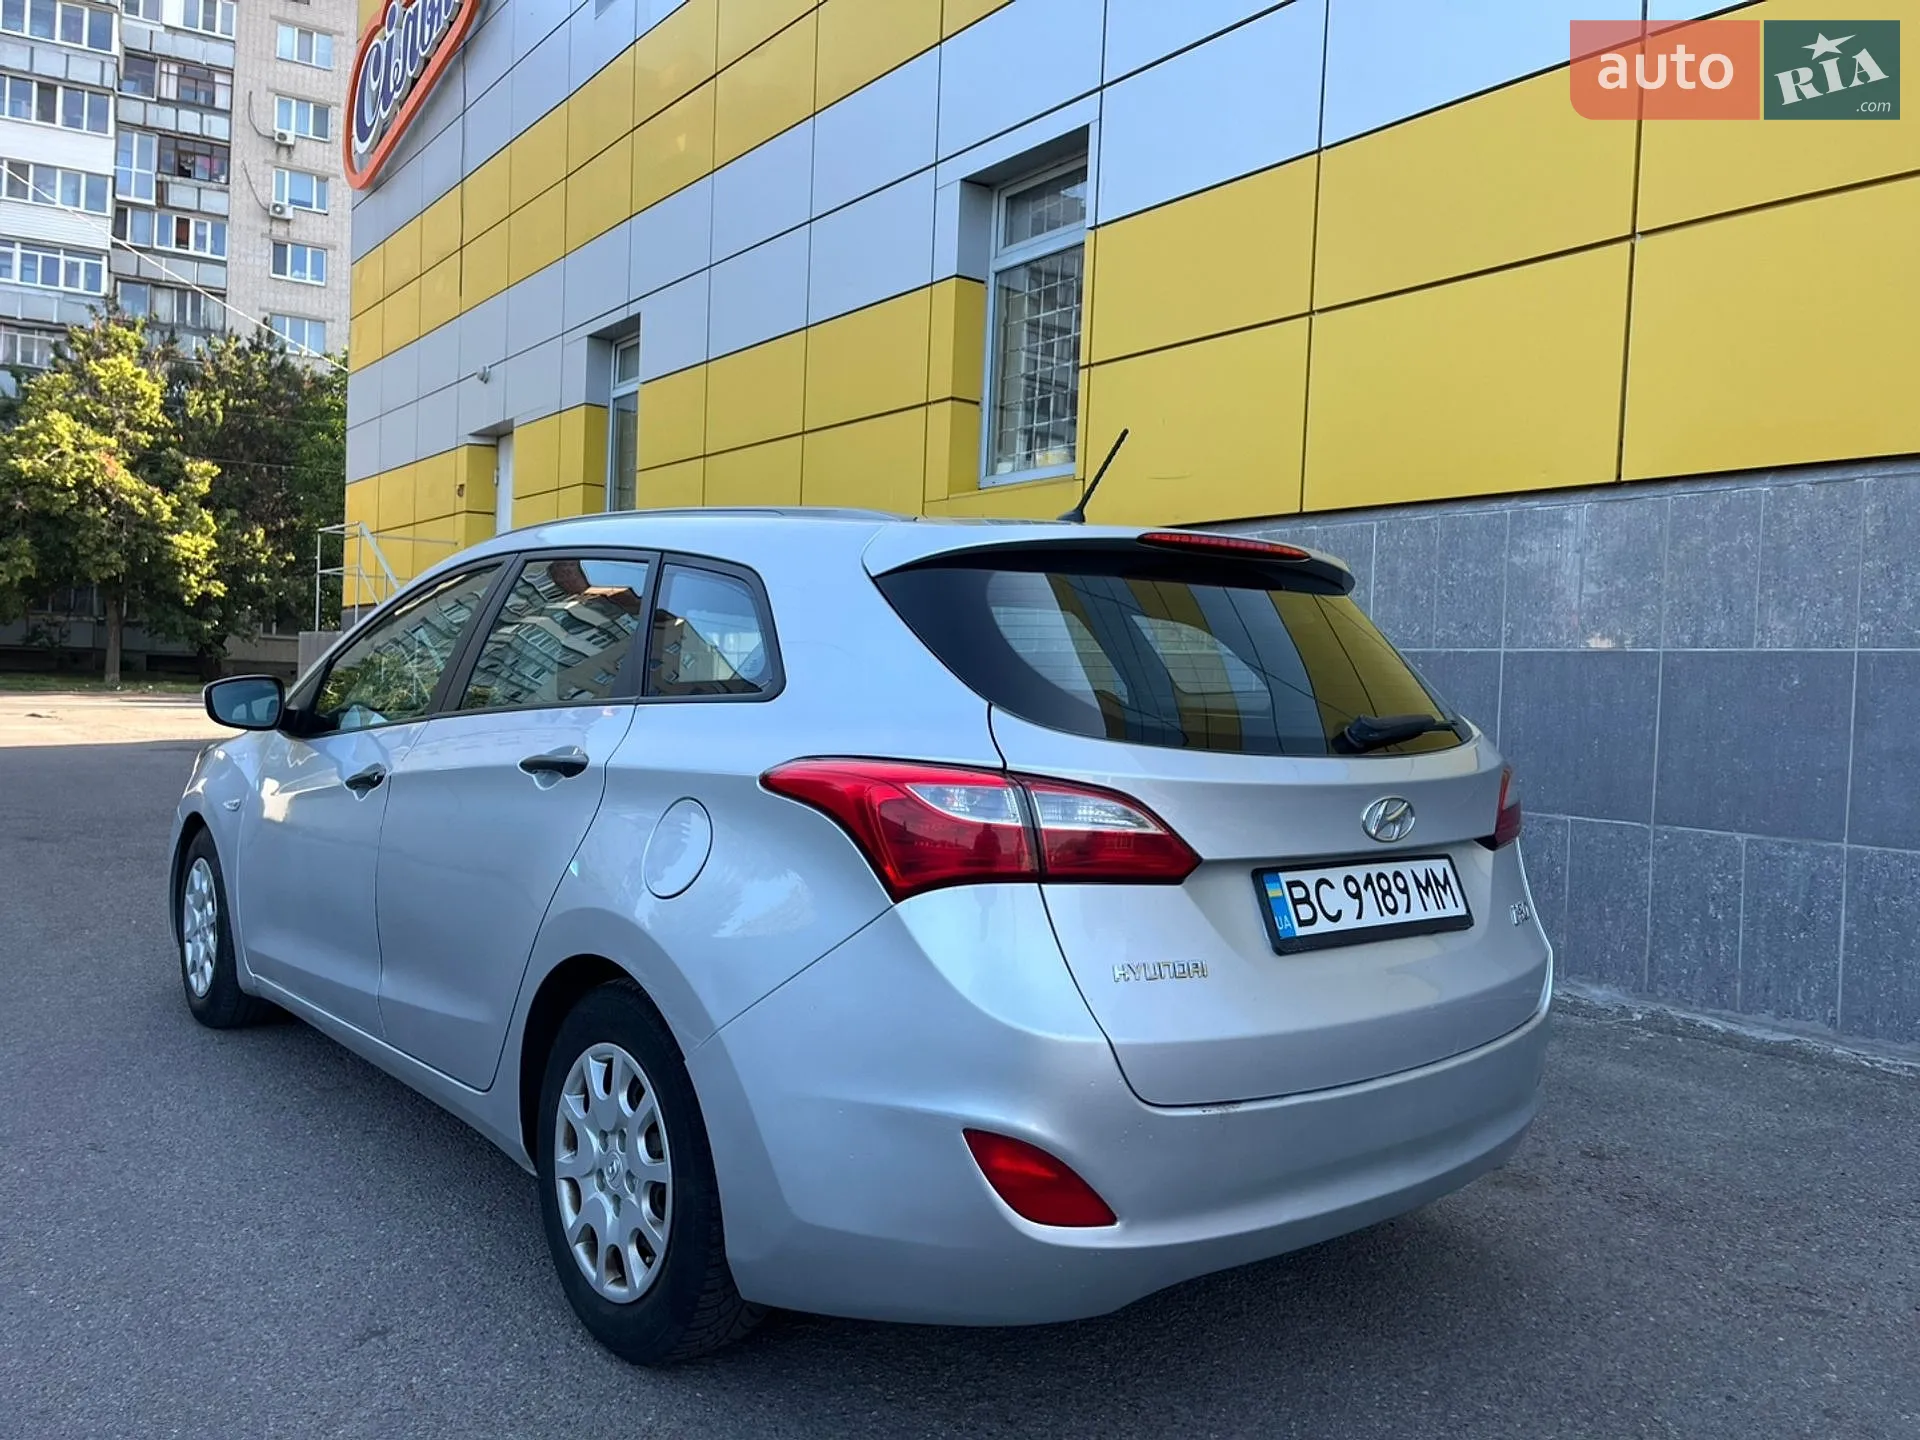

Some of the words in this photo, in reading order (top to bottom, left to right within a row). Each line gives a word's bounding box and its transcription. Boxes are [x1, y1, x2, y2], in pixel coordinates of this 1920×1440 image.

[1286, 877, 1342, 927] BC
[1343, 870, 1411, 920] 9189
[1411, 867, 1459, 911] MM
[1275, 915, 1292, 930] UA
[1112, 960, 1208, 982] HYUNDAI
